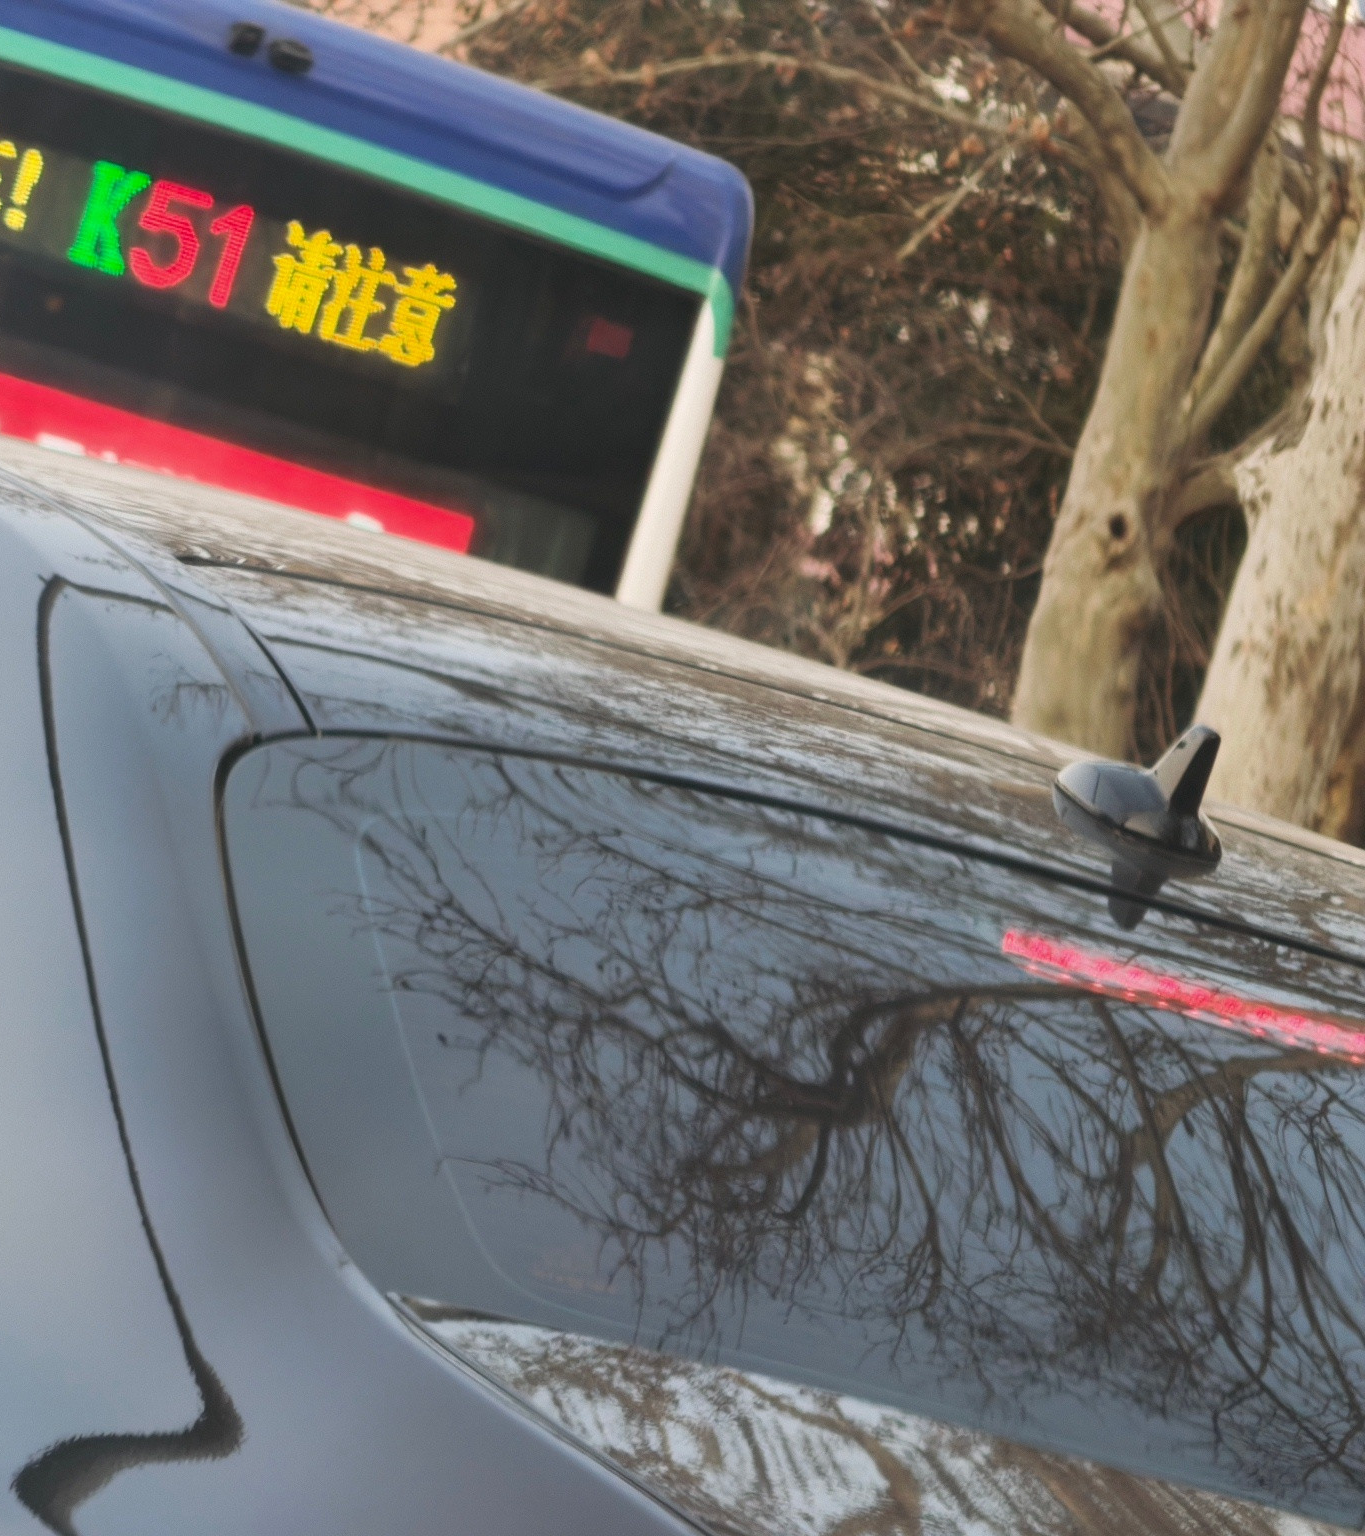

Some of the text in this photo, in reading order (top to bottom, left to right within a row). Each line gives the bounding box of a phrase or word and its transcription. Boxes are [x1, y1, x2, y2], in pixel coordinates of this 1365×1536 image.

[67, 160, 255, 309] K51
[266, 220, 457, 367] 请注意
